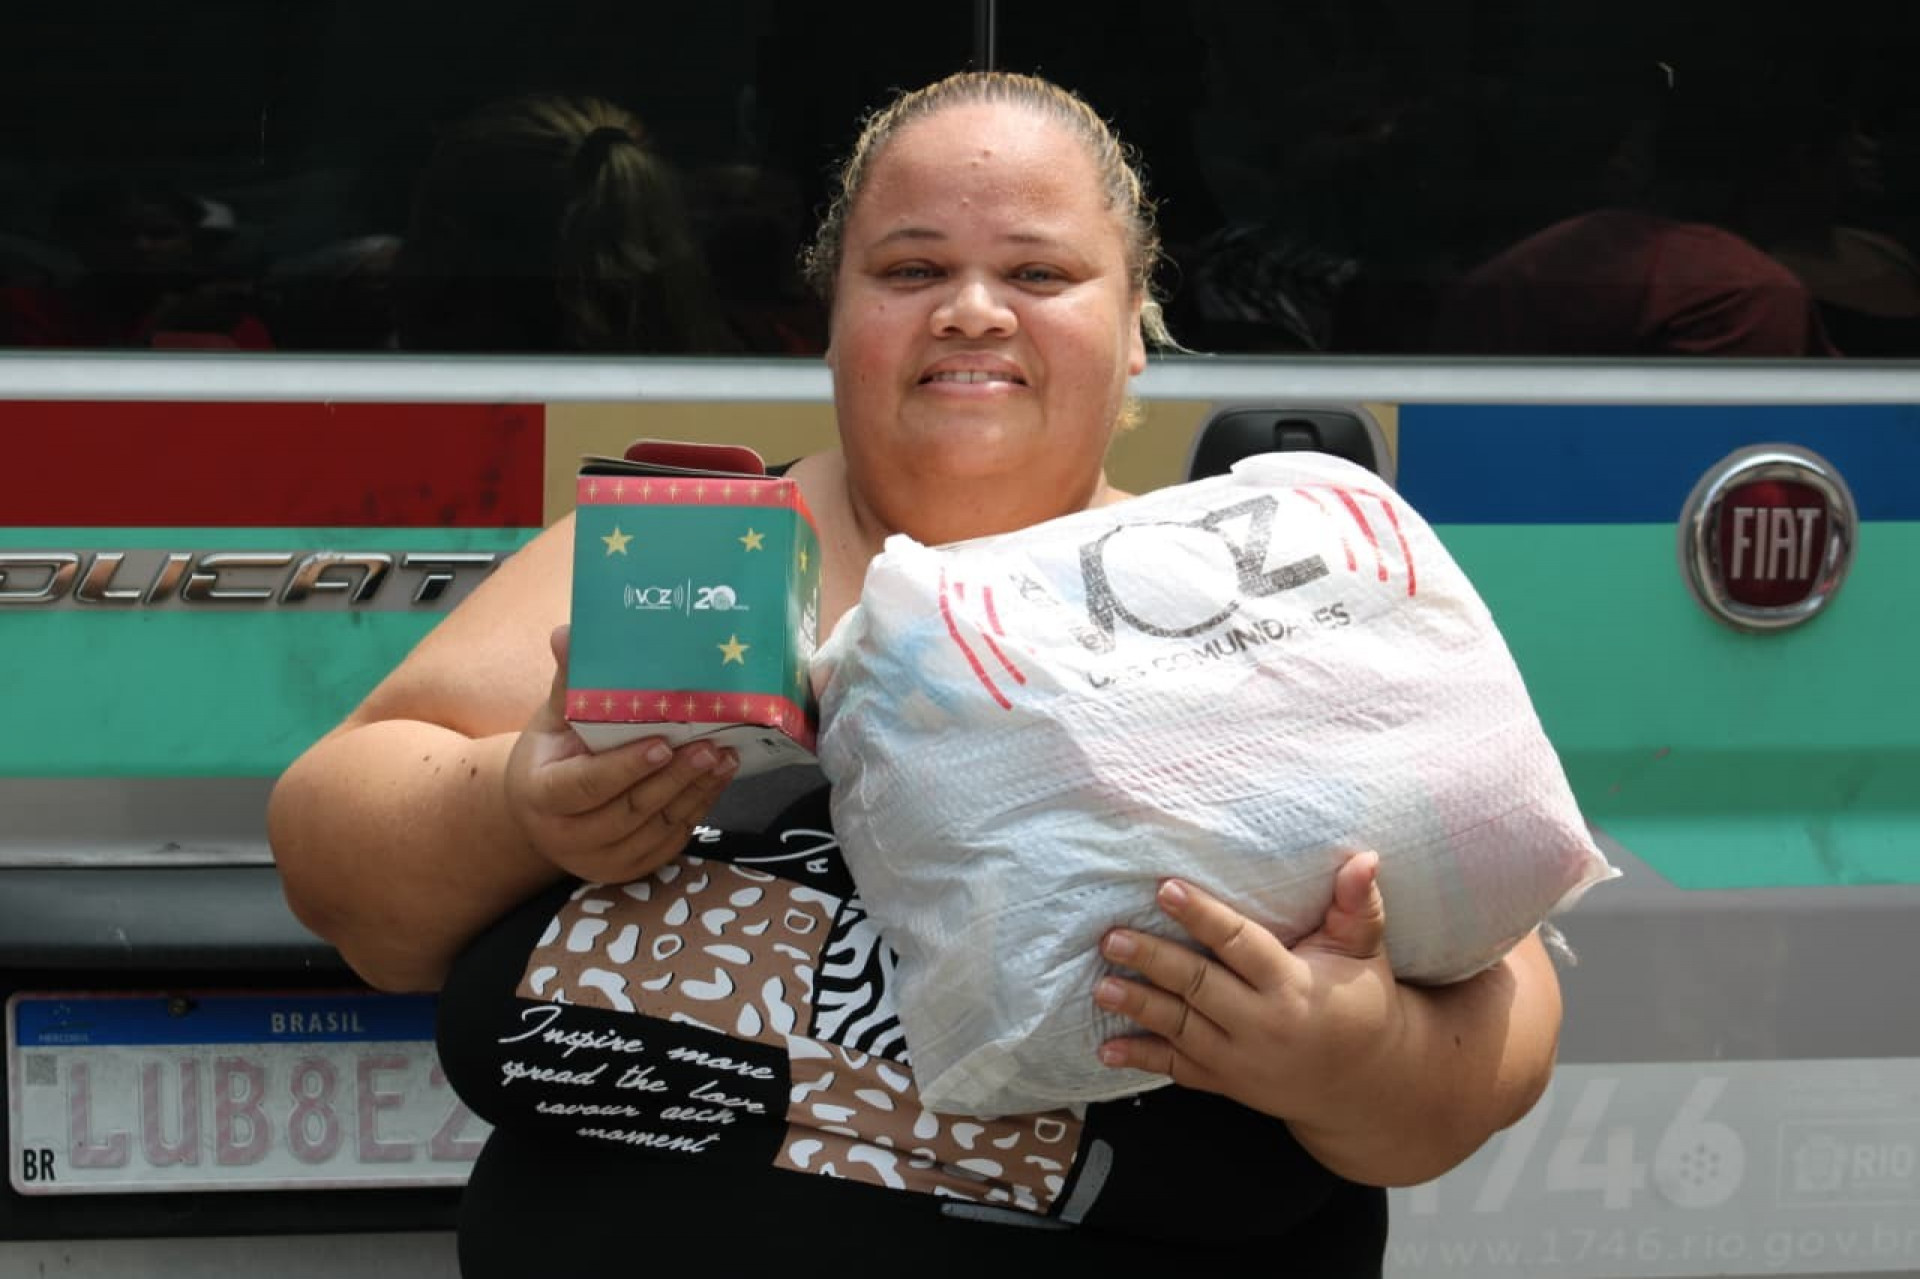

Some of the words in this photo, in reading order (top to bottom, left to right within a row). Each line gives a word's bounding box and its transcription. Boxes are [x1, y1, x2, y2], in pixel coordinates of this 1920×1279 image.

[1730, 507, 1822, 580] FIAT
[0, 551, 506, 606] DUCAT
[1152, 603, 1352, 673] COMUNIDES
[271, 1012, 364, 1034] BRASIL
[498, 1005, 645, 1058] Inspire
[666, 1046, 776, 1079] more
[501, 1060, 609, 1087] spread
[615, 1065, 669, 1092] the
[23, 1149, 55, 1181] BR
[1406, 1076, 1746, 1214] 746
[1852, 1143, 1915, 1179] RIO
